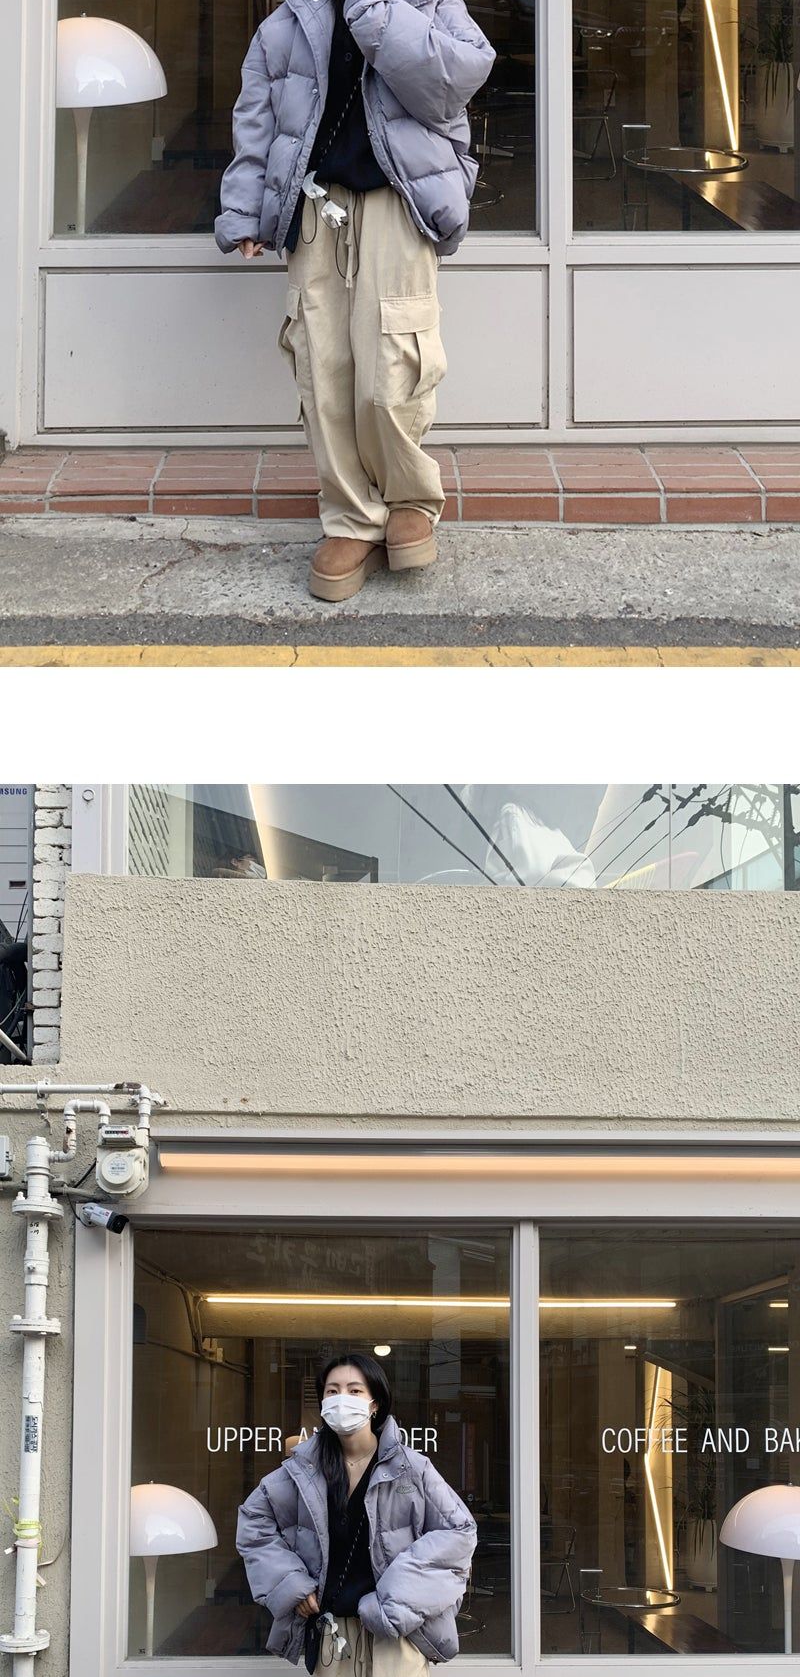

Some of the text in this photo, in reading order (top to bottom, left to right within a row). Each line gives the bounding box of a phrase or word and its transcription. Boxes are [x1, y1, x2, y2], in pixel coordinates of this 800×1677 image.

[207, 1426, 282, 1453] UPPER
[601, 1427, 688, 1454] COFFEE
[701, 1427, 750, 1453] AND
